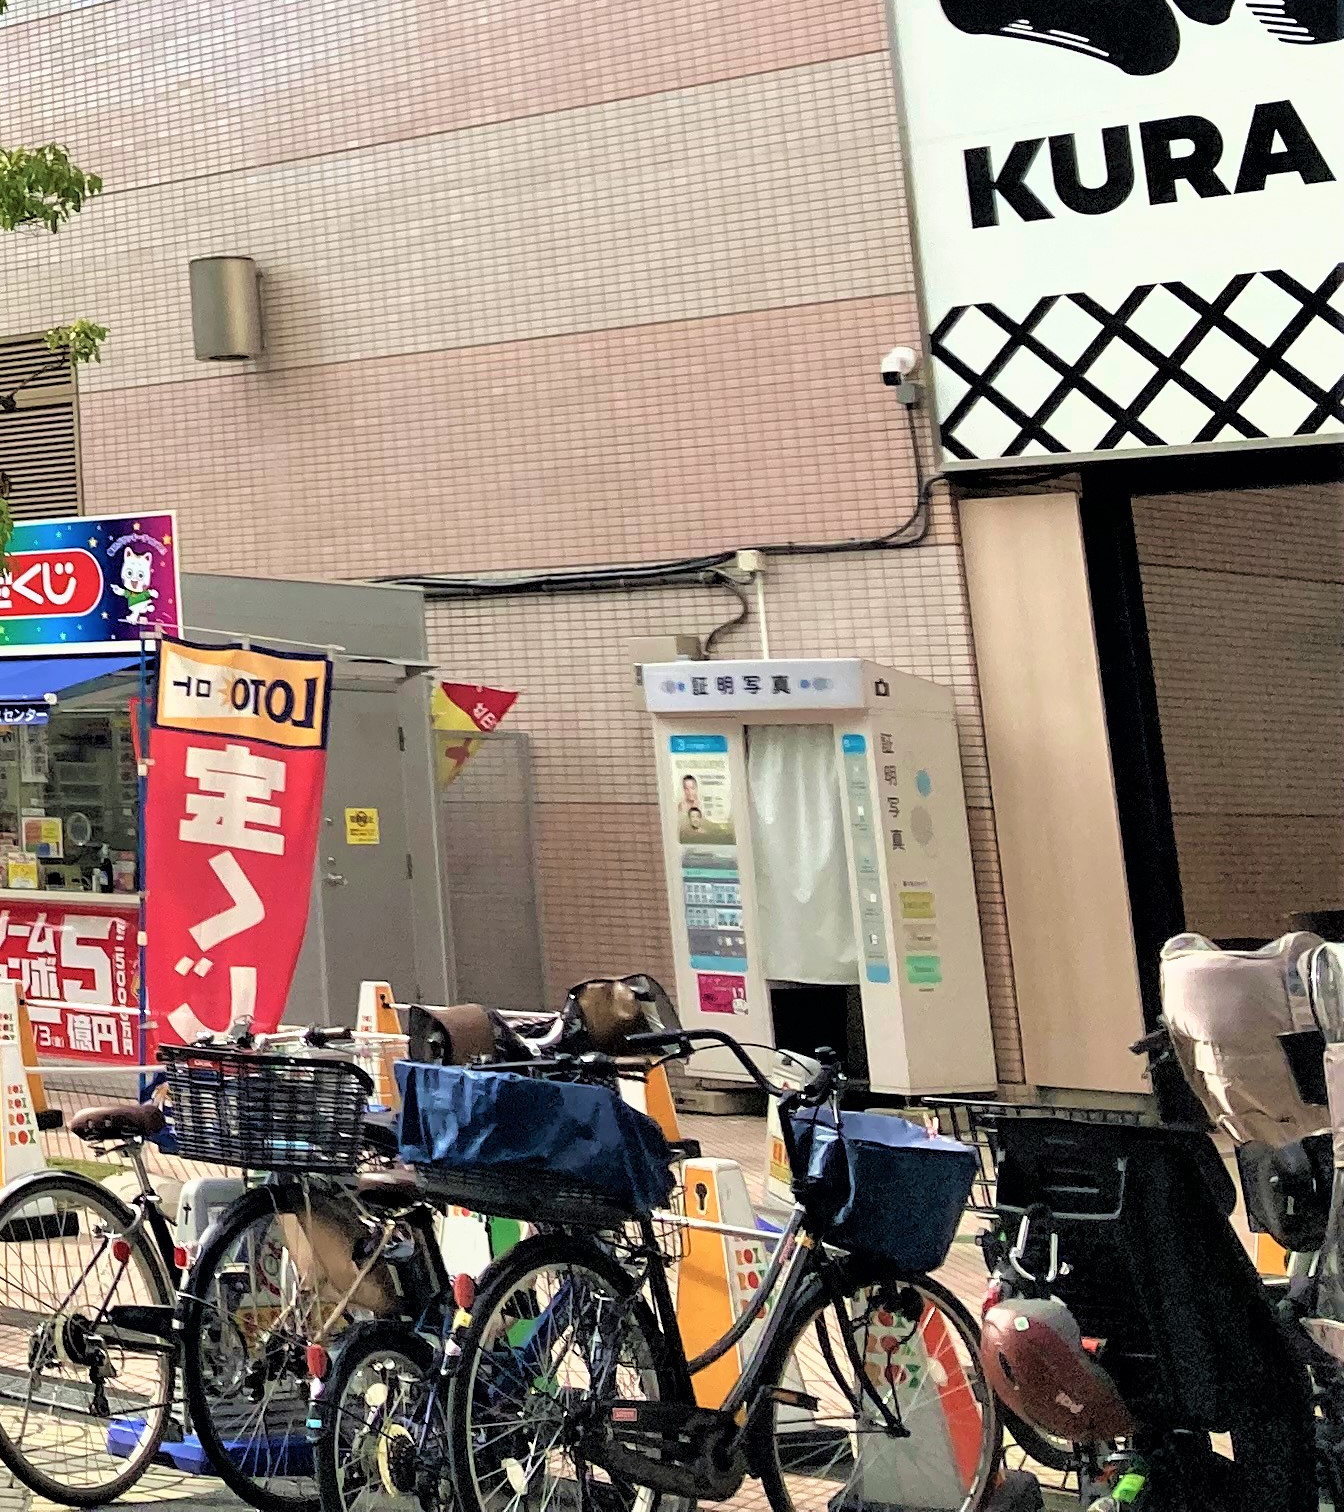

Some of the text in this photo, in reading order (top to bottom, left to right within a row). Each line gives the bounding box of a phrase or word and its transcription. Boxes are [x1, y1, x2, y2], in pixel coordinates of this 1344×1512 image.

[963, 99, 1338, 229] KURA
[690, 675, 791, 696] 証明写真
[61, 914, 114, 1005] 5
[66, 1013, 121, 1055] 億円
